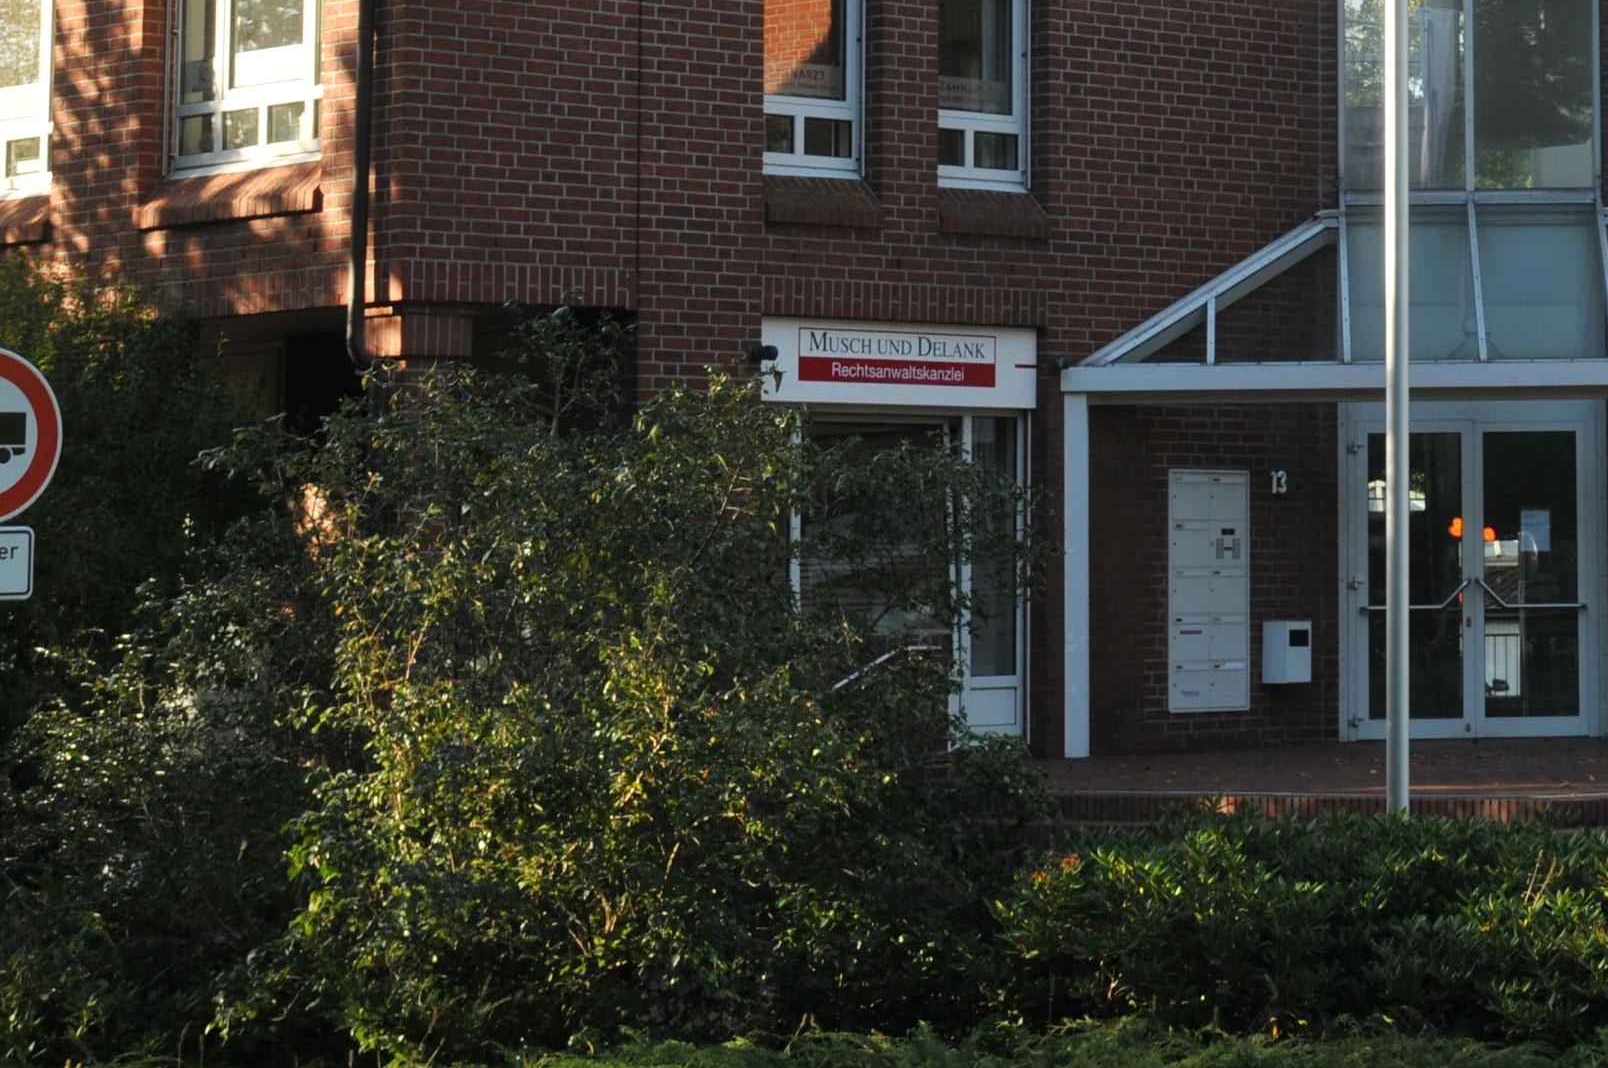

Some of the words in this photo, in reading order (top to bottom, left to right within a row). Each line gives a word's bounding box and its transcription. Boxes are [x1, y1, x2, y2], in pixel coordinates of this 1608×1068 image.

[808, 331, 872, 354] MUSCH
[877, 338, 912, 356] UND
[917, 336, 986, 359] DELANK
[831, 361, 965, 382] Rechtsanwaltskanzlei
[1269, 470, 1287, 494] 13
